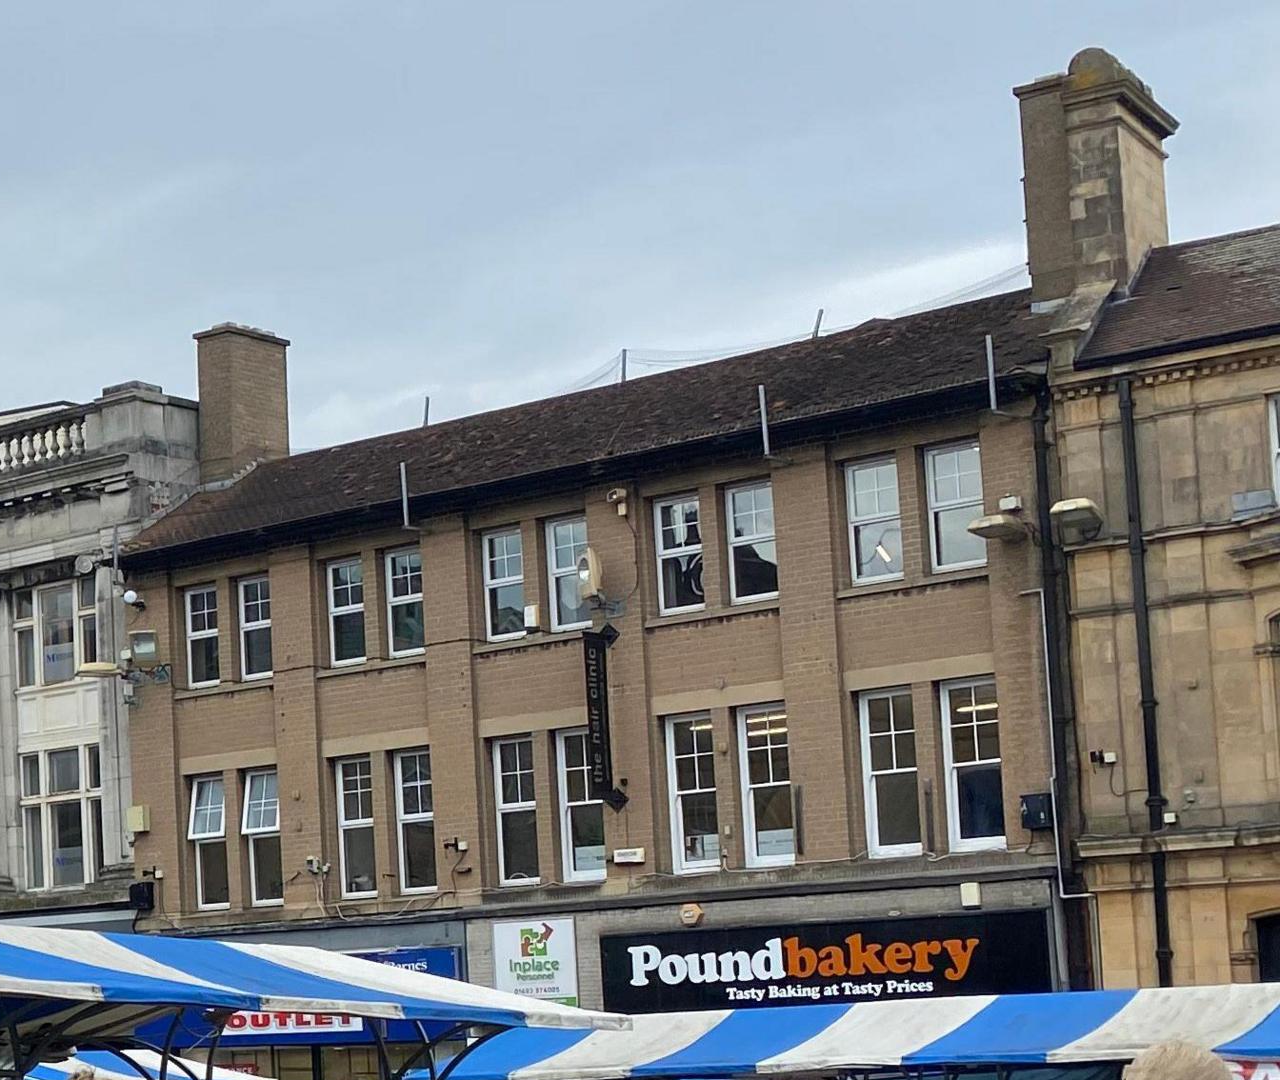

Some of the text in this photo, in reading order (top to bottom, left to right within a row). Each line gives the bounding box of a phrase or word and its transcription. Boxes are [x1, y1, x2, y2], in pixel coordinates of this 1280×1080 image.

[509, 959, 560, 973] Inplace
[627, 933, 980, 986] Poundbakery
[516, 973, 555, 981] Personnel
[726, 979, 934, 1001] Tasty Baking at Tasty Prices
[226, 1011, 352, 1030] OUTLET
